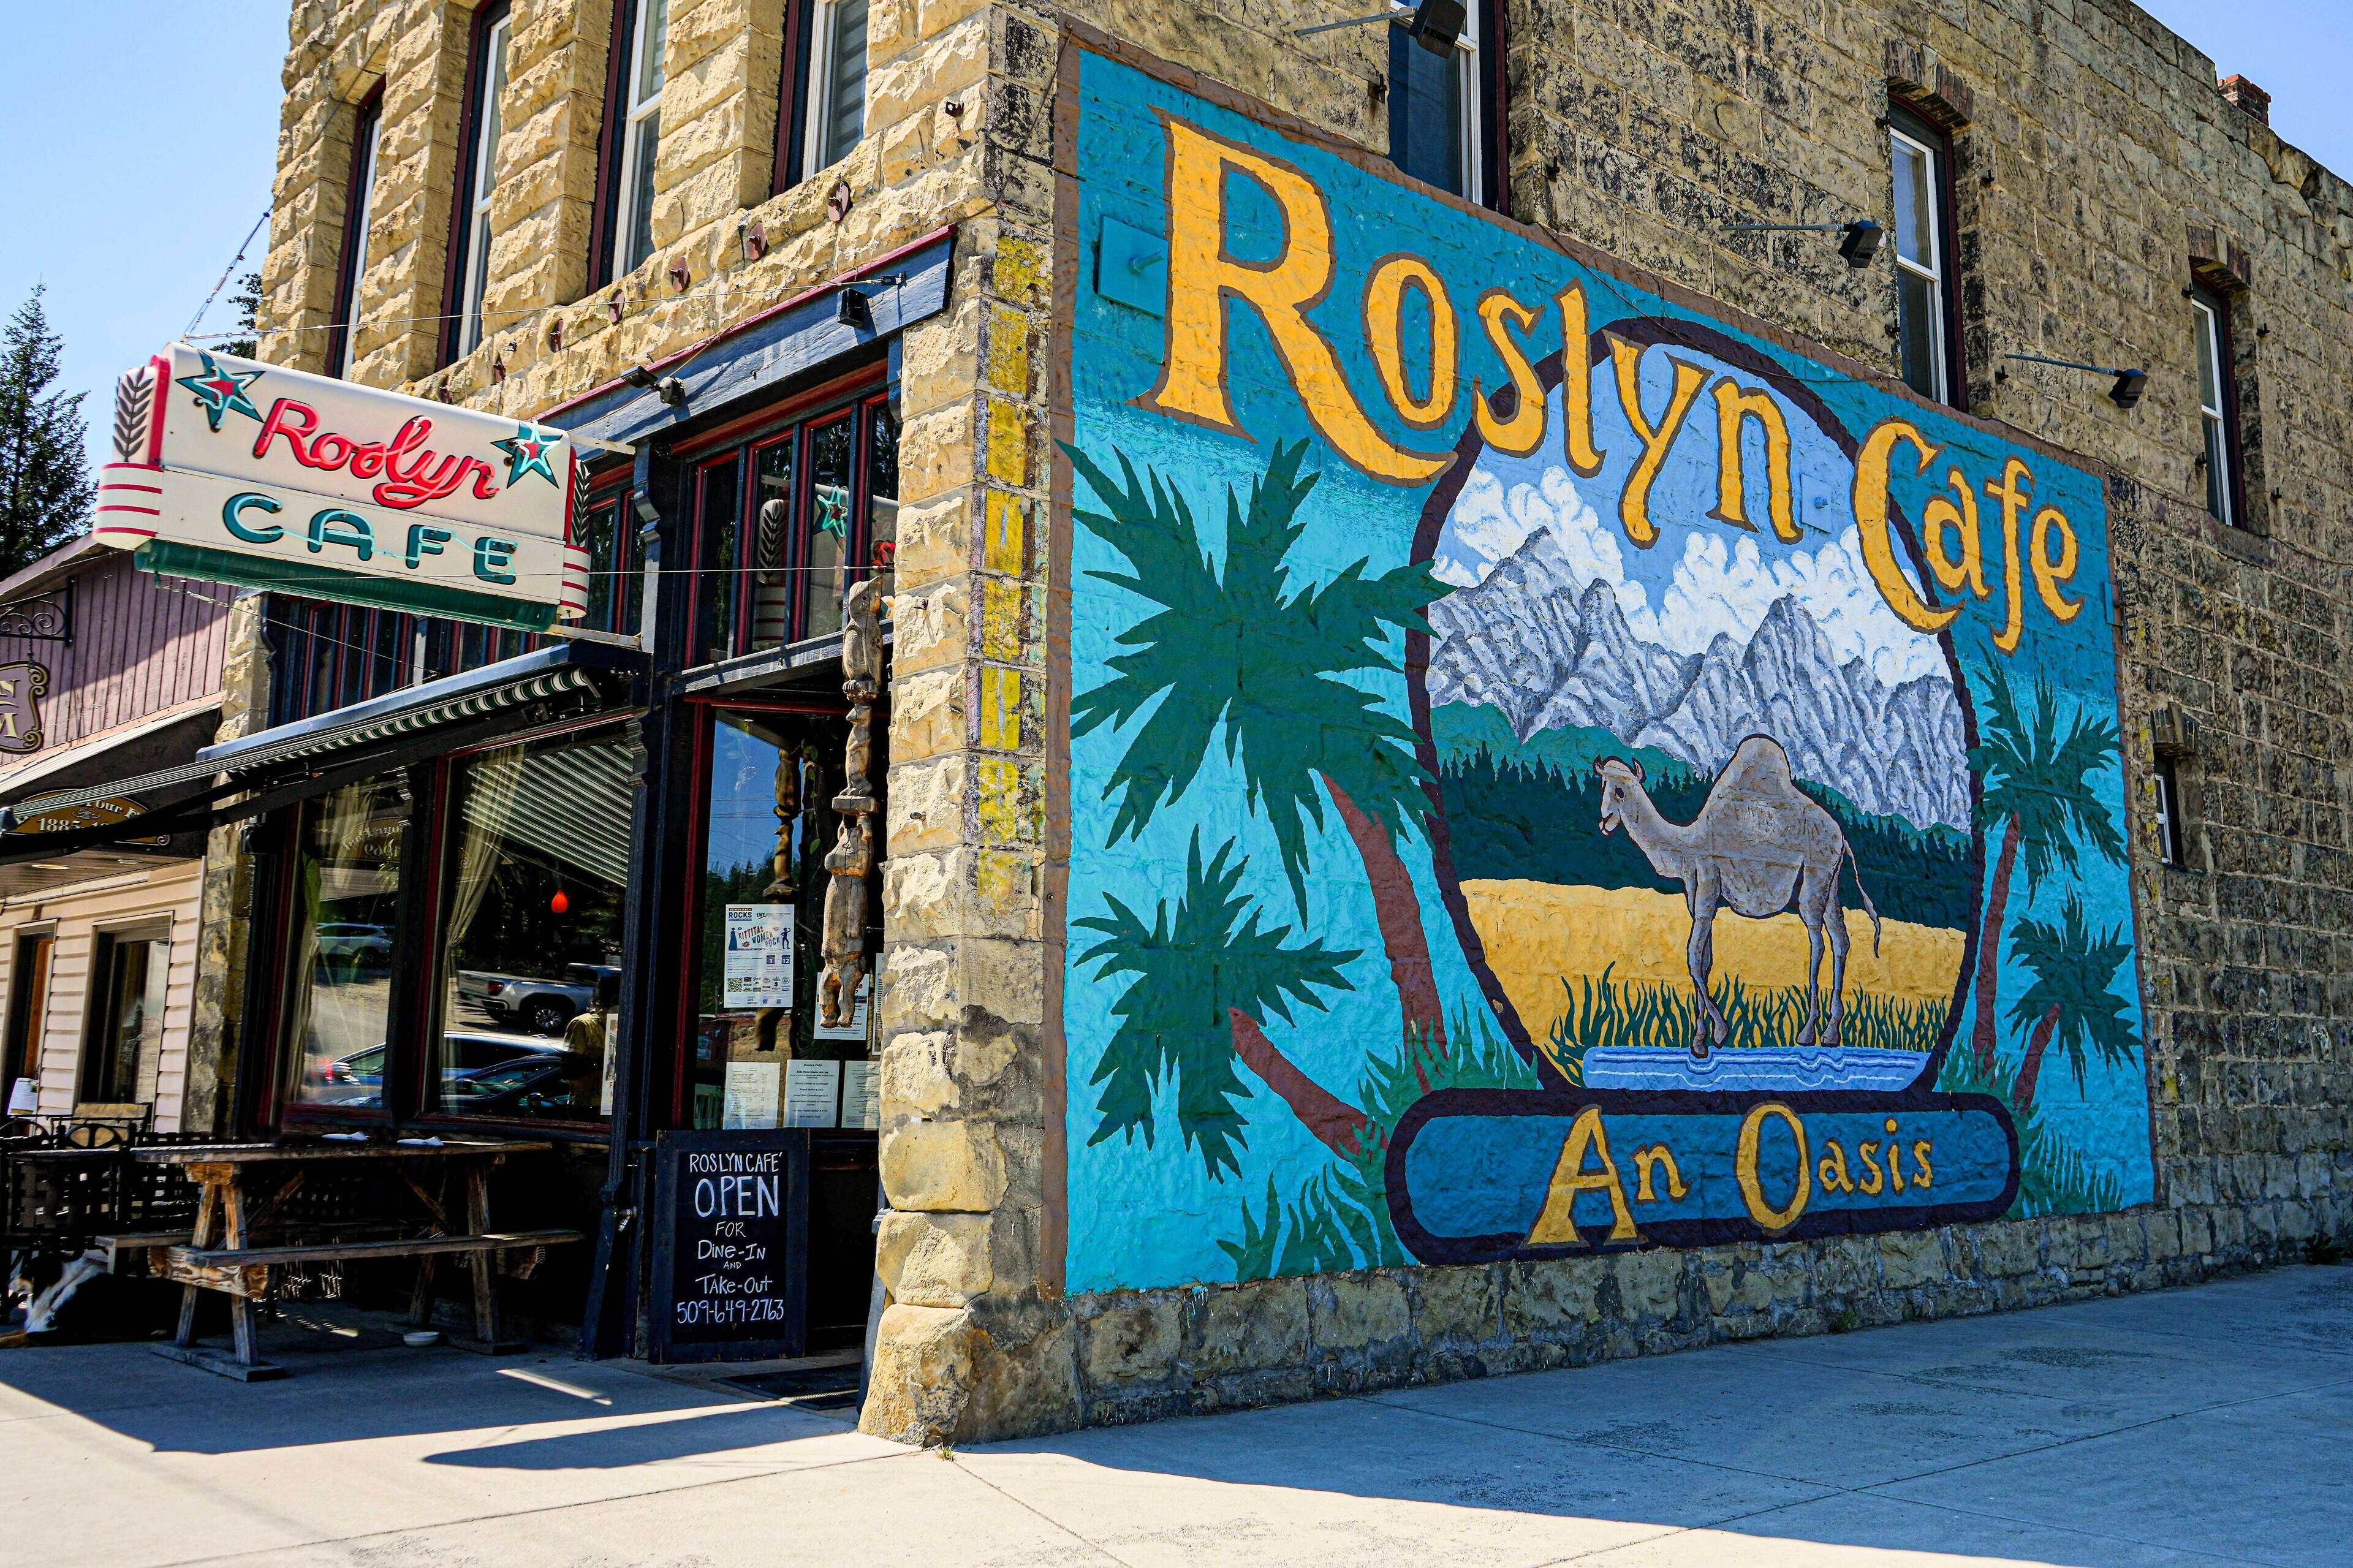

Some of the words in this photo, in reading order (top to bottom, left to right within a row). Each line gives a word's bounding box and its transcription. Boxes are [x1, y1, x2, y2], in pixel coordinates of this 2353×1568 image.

[1126, 103, 1803, 550] Roslyn
[1849, 415, 2085, 656] Cafe
[252, 397, 500, 509] Roslyn
[222, 492, 518, 585] CAFE
[738, 926, 764, 939] KITTITAS
[751, 931, 773, 944] WOMEN
[765, 937, 781, 947] ROCK
[689, 1153, 743, 1173] ROSLYN
[1518, 1104, 1691, 1247] An
[1735, 1100, 1934, 1235] Oasis
[695, 1175, 779, 1218] OPEN
[715, 1221, 746, 1237] FOR
[677, 1299, 784, 1324] 509-649-2763
